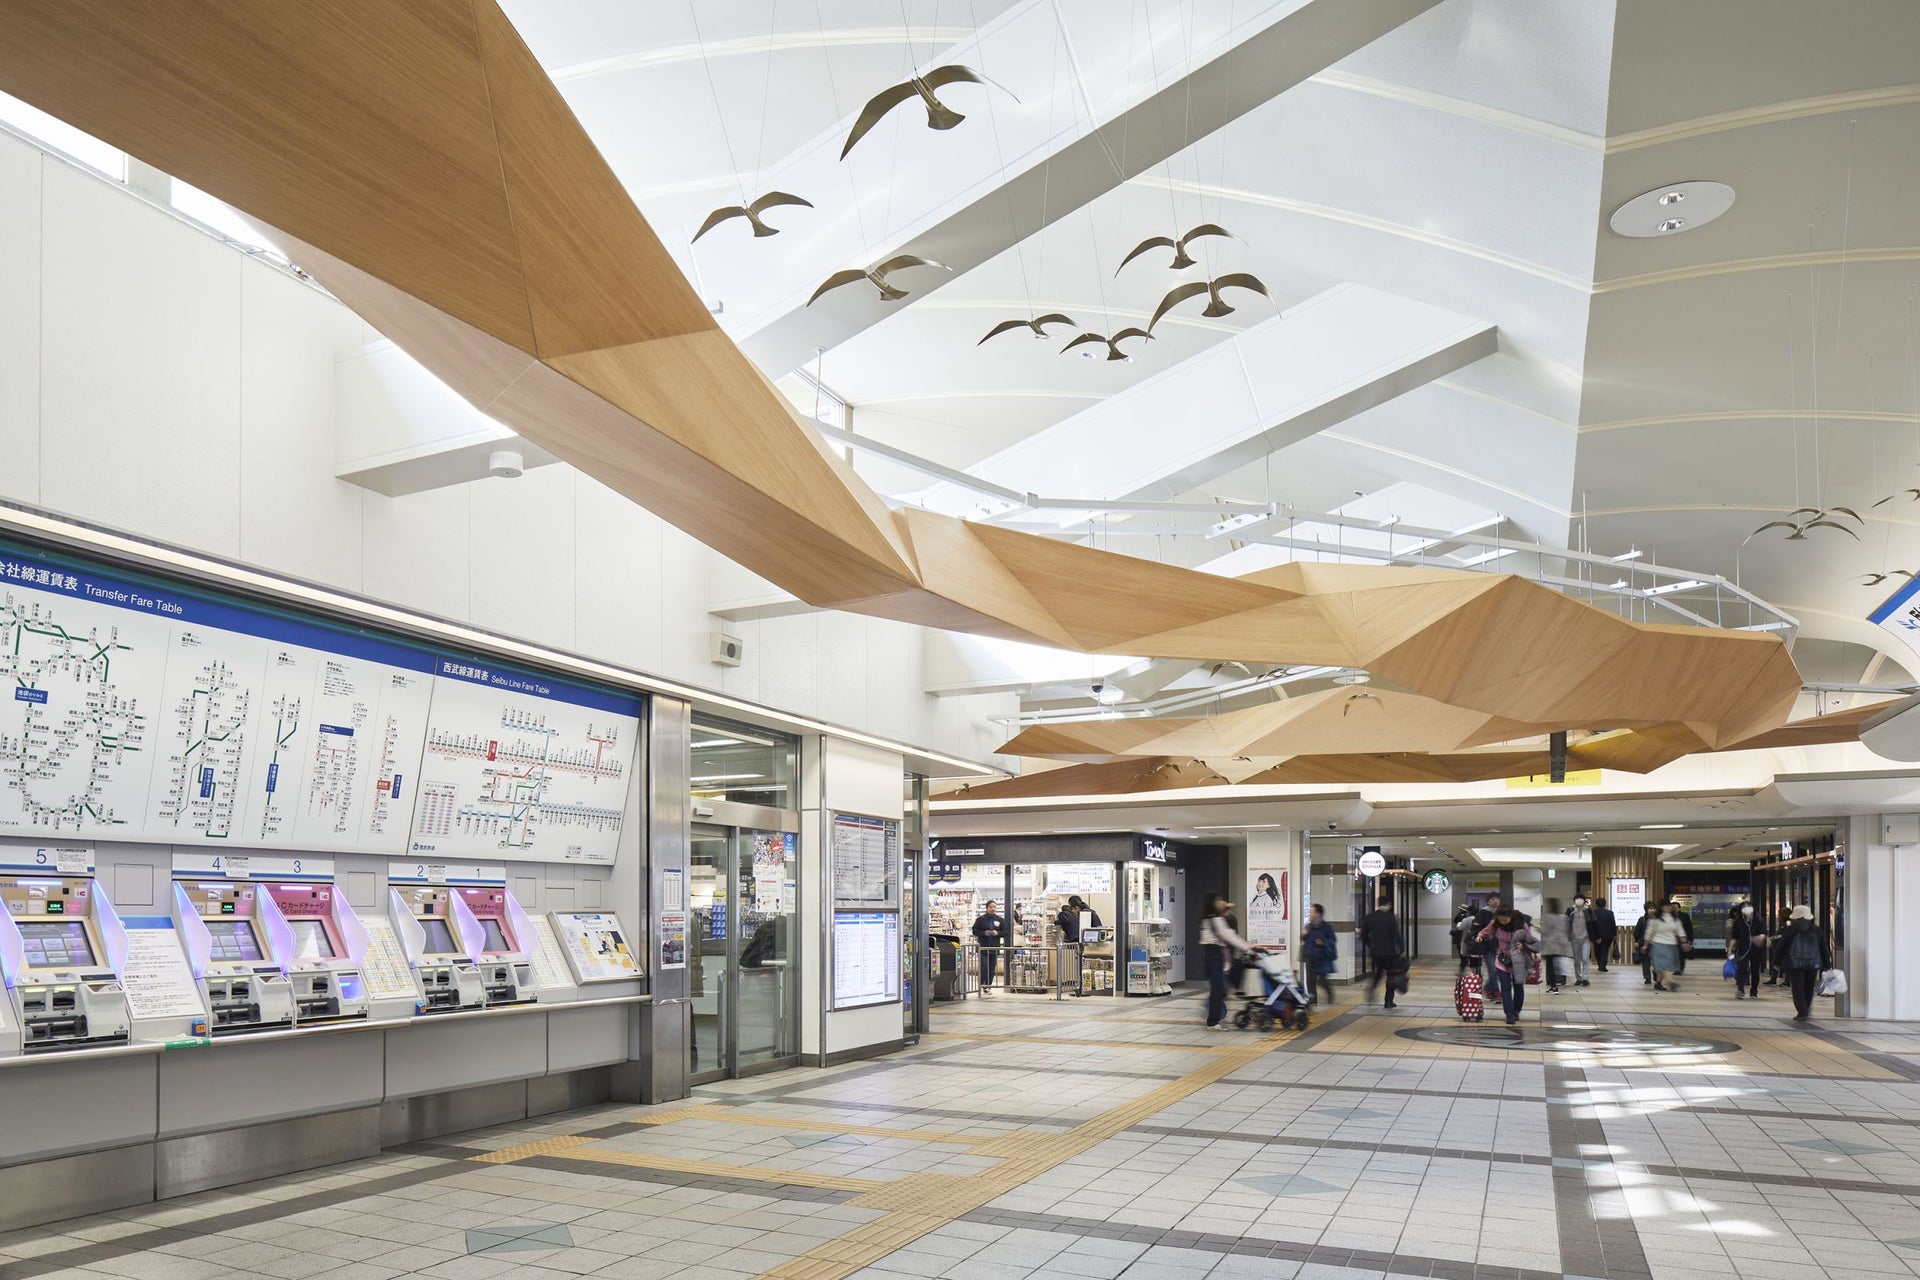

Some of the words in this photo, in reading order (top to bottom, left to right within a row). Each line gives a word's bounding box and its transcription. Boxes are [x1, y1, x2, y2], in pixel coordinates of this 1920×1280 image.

[85, 583, 129, 603] Transfer
[130, 594, 154, 609] Fare
[156, 600, 183, 615] Table
[443, 662, 489, 682] 西武線運賃表
[491, 675, 509, 687] Seibu
[509, 679, 521, 689] Line
[521, 682, 535, 692] Fare
[535, 685, 550, 695] Table
[36, 848, 47, 864] 5
[212, 856, 221, 871] 4
[293, 860, 302, 873] 3
[417, 865, 424, 877] 2
[476, 868, 480, 879] 1
